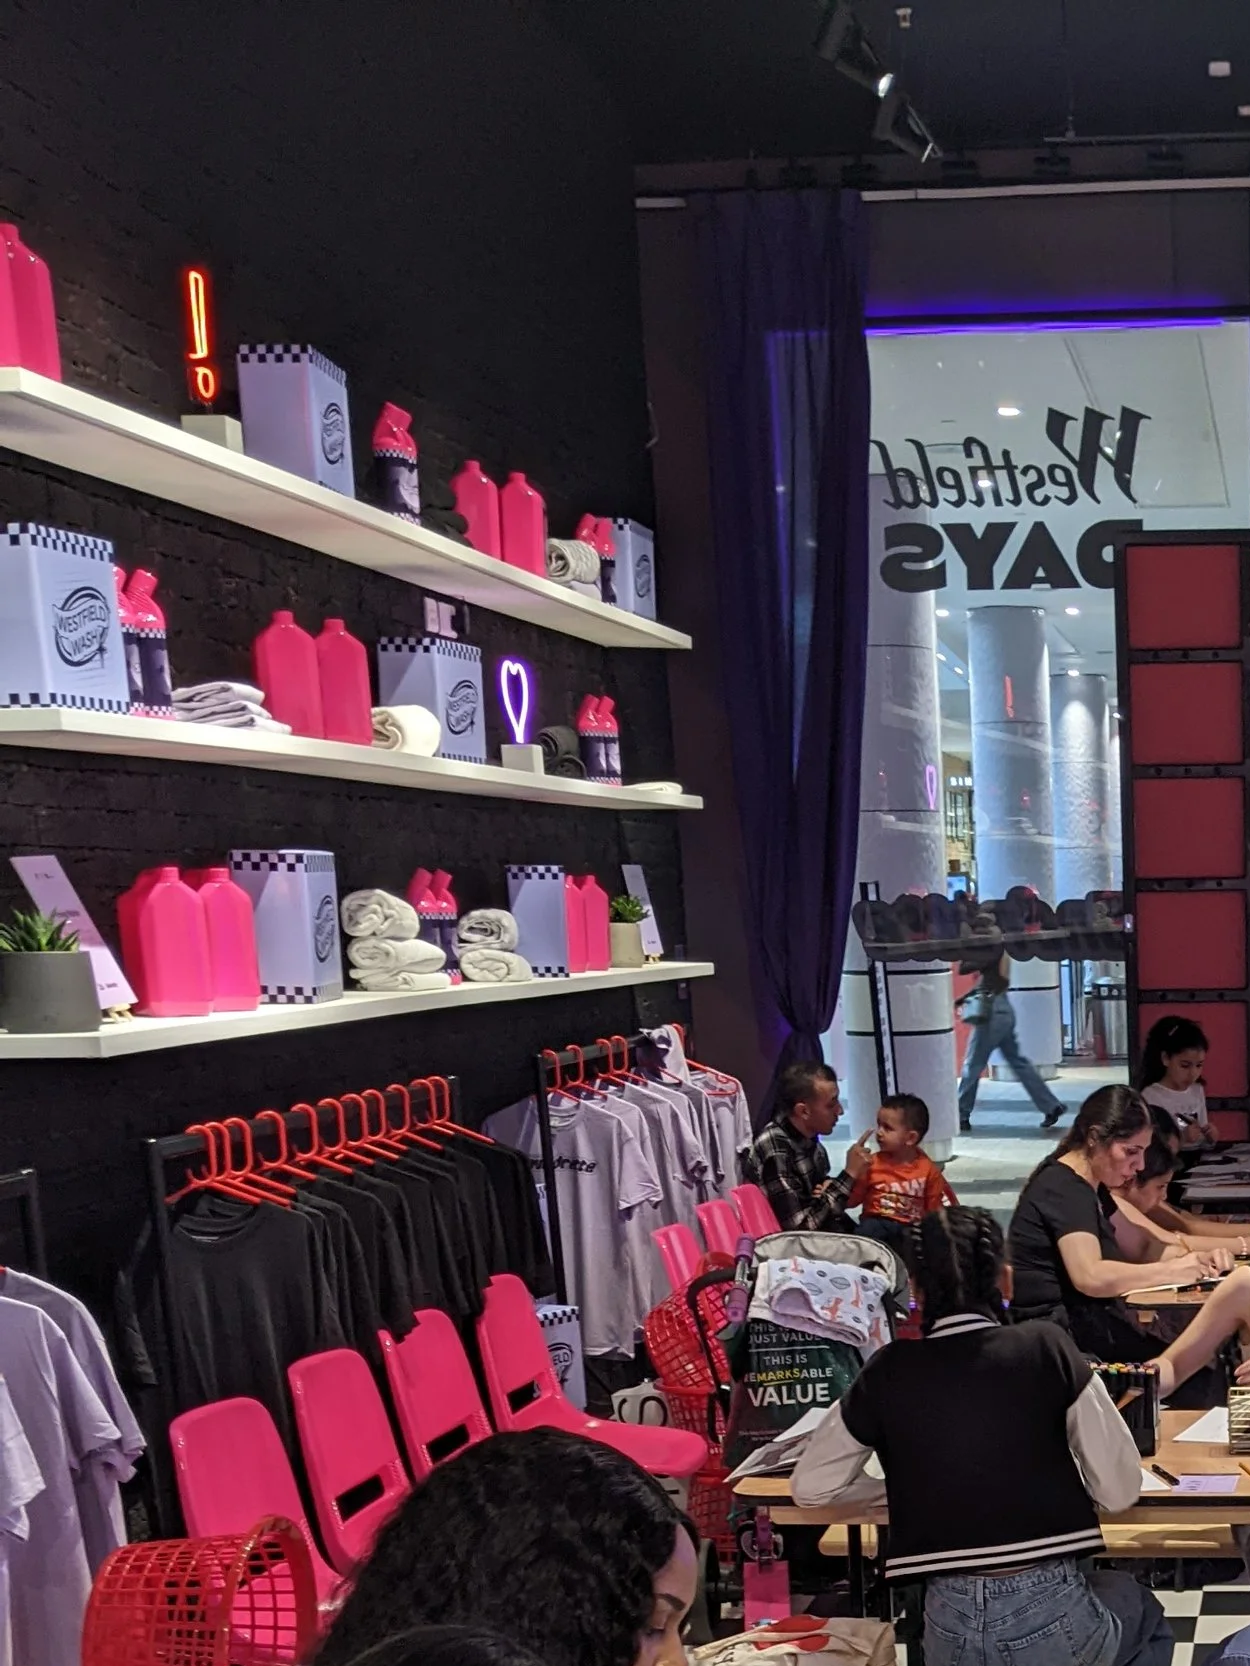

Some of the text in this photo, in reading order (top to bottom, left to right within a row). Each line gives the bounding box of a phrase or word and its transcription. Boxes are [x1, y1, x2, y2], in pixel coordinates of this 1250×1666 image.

[58, 604, 107, 634] WESTFIELD
[70, 631, 101, 656] WASH
[763, 1353, 808, 1366] THIS IS
[748, 1382, 831, 1407] VALUE
